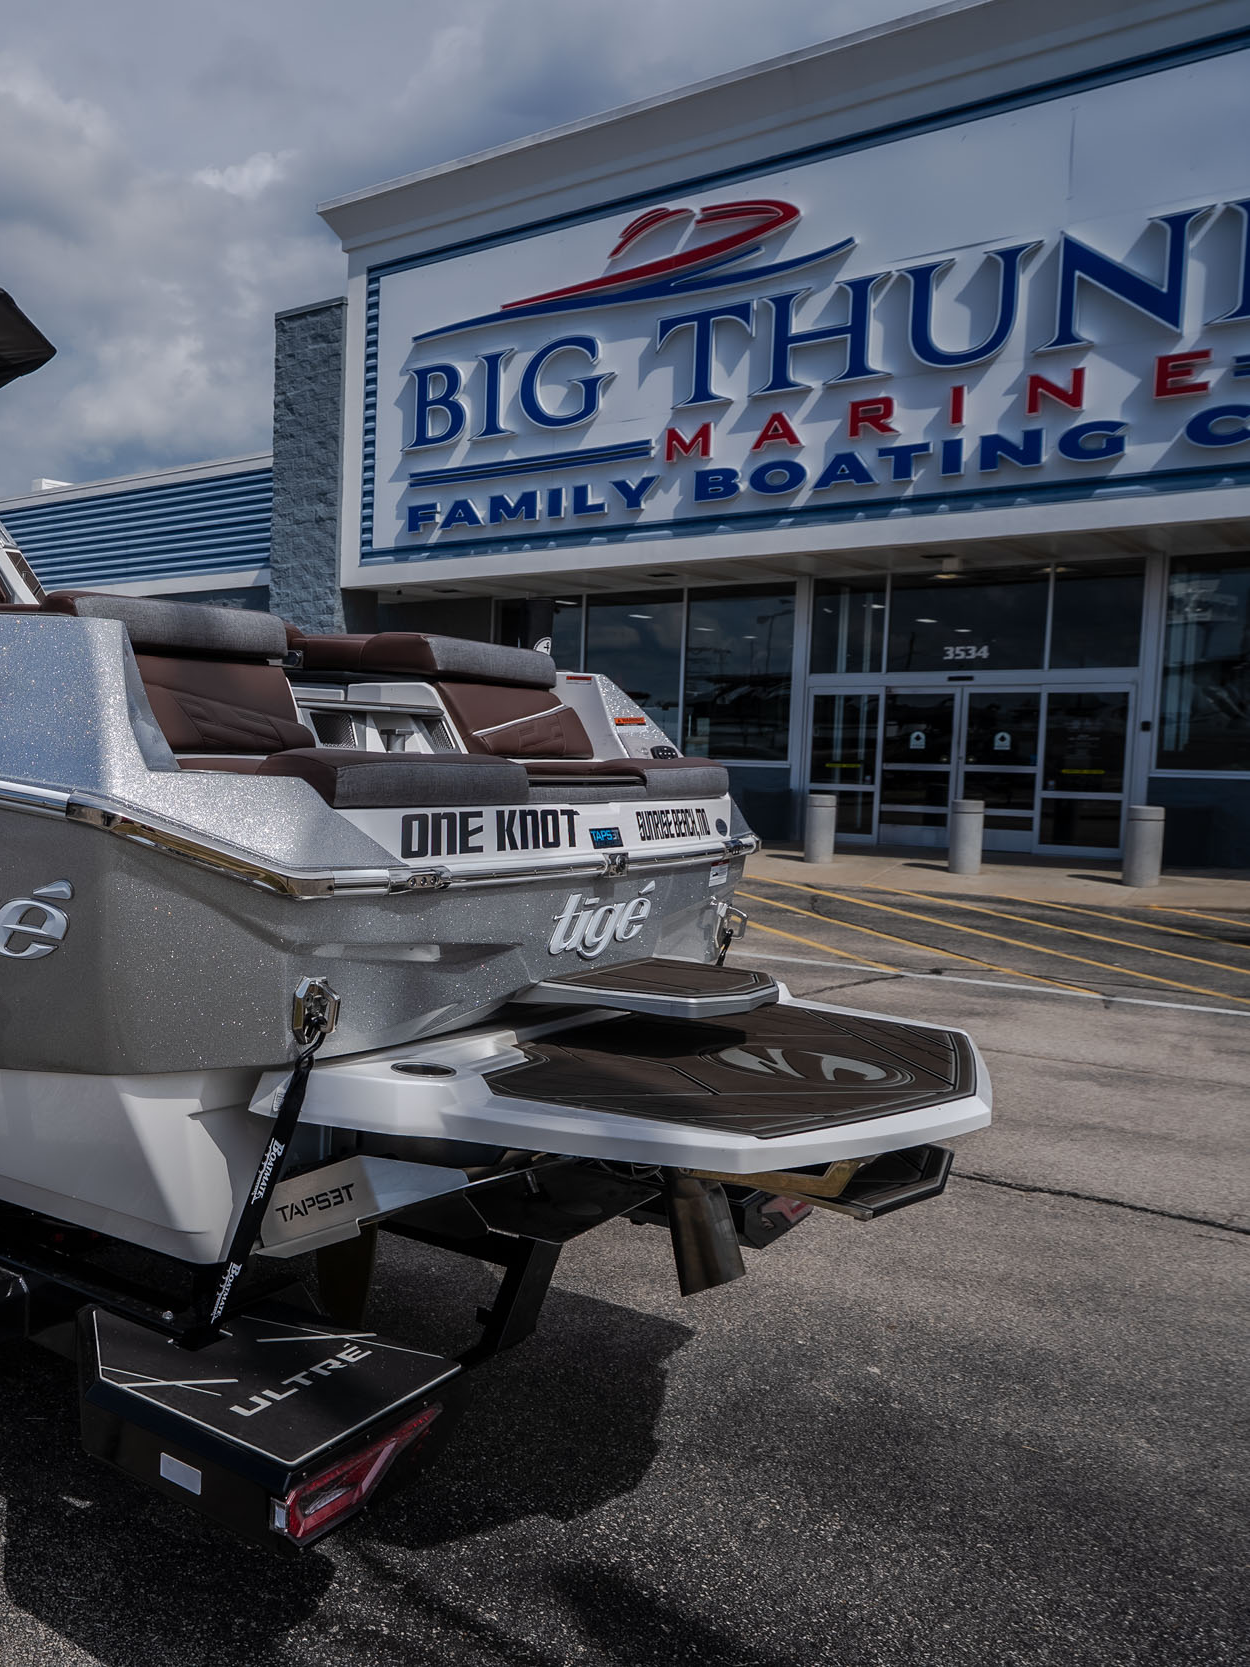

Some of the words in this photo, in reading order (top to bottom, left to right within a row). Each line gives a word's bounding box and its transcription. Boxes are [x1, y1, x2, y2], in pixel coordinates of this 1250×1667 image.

[401, 335, 618, 452] BIG
[665, 348, 1213, 463] MARINE
[408, 475, 661, 533] FAMILY
[694, 419, 1128, 502] BOATING
[943, 645, 990, 660] 3534
[401, 811, 484, 859] ONE
[496, 809, 580, 852] KNOT
[636, 809, 676, 841] SUNRISE
[549, 880, 656, 960] tigé
[230, 1343, 373, 1417] ULTRÉ
